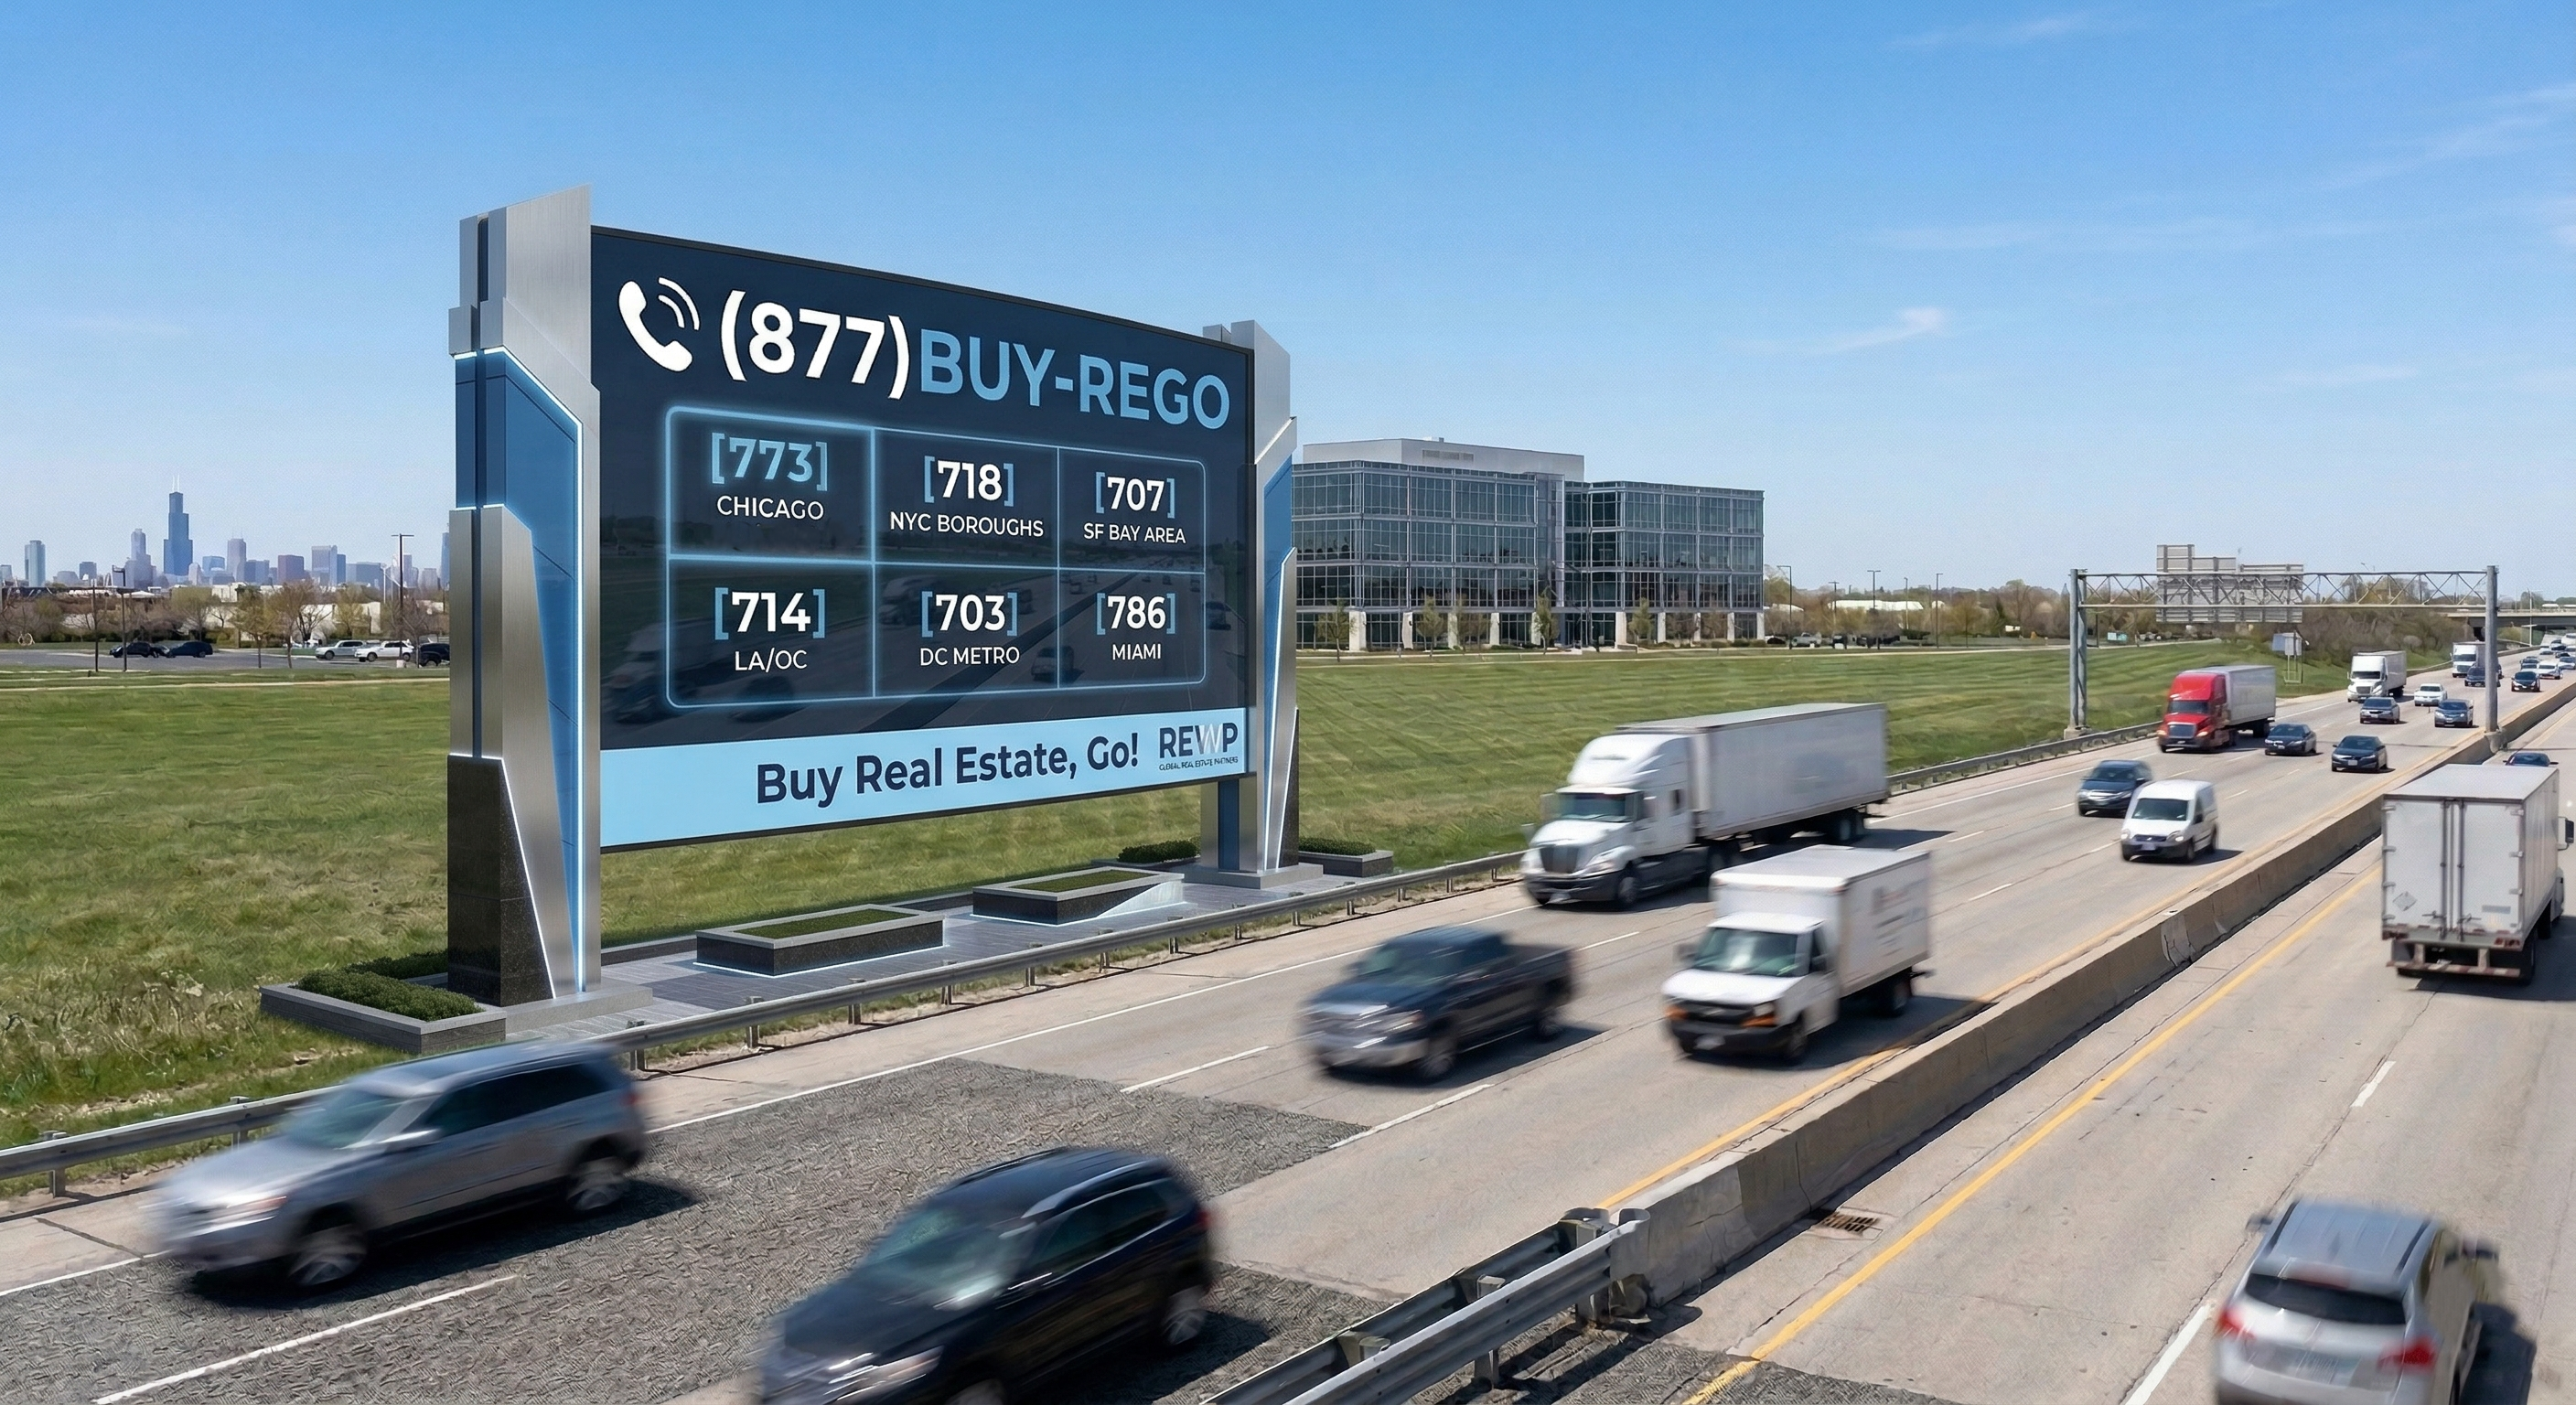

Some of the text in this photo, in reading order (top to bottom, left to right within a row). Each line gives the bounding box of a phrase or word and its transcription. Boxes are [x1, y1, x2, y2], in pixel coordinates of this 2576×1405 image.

[712, 433, 828, 492] [773]
[924, 456, 1014, 508] [718]
[716, 495, 824, 520] CHICAGO
[1095, 471, 1175, 520] [707]
[890, 510, 1044, 538] NYC BOROUGHS
[1083, 522, 1186, 544] SF BAY AREA
[714, 587, 825, 640] [714]
[921, 591, 1018, 638] [703]
[1096, 592, 1175, 636] [786]
[735, 647, 808, 673] LA/OC
[919, 646, 1020, 666] DC METRO
[1112, 643, 1162, 660] MIAMI
[757, 732, 1138, 809] Buy Real Estate, Go!
